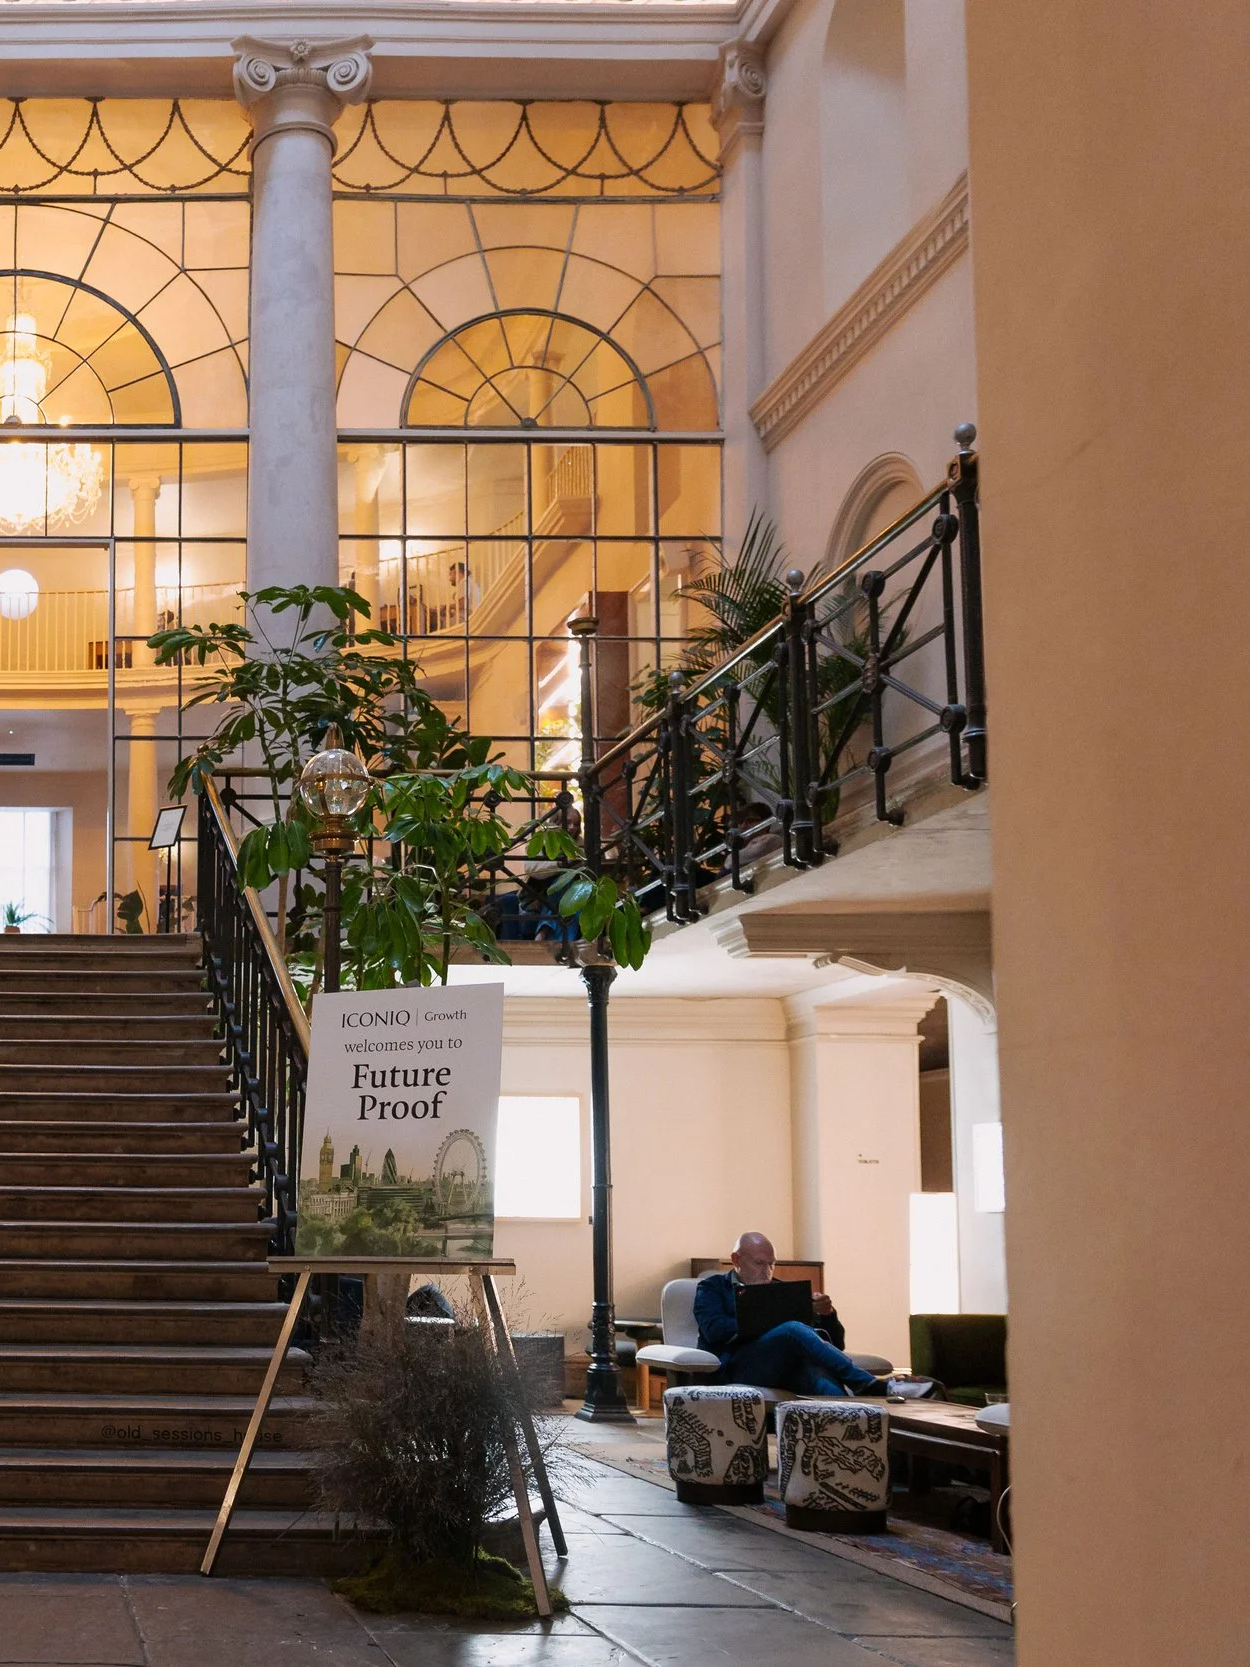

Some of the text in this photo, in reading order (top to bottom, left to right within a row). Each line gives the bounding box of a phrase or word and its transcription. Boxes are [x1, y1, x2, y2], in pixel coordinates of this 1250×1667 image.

[341, 1009, 467, 1029] ICONIQ Growth
[344, 1037, 463, 1054] welcomes you to
[351, 1063, 451, 1089] Future
[356, 1090, 448, 1121] Proof
[101, 1424, 283, 1444] @old_sessions_hse
